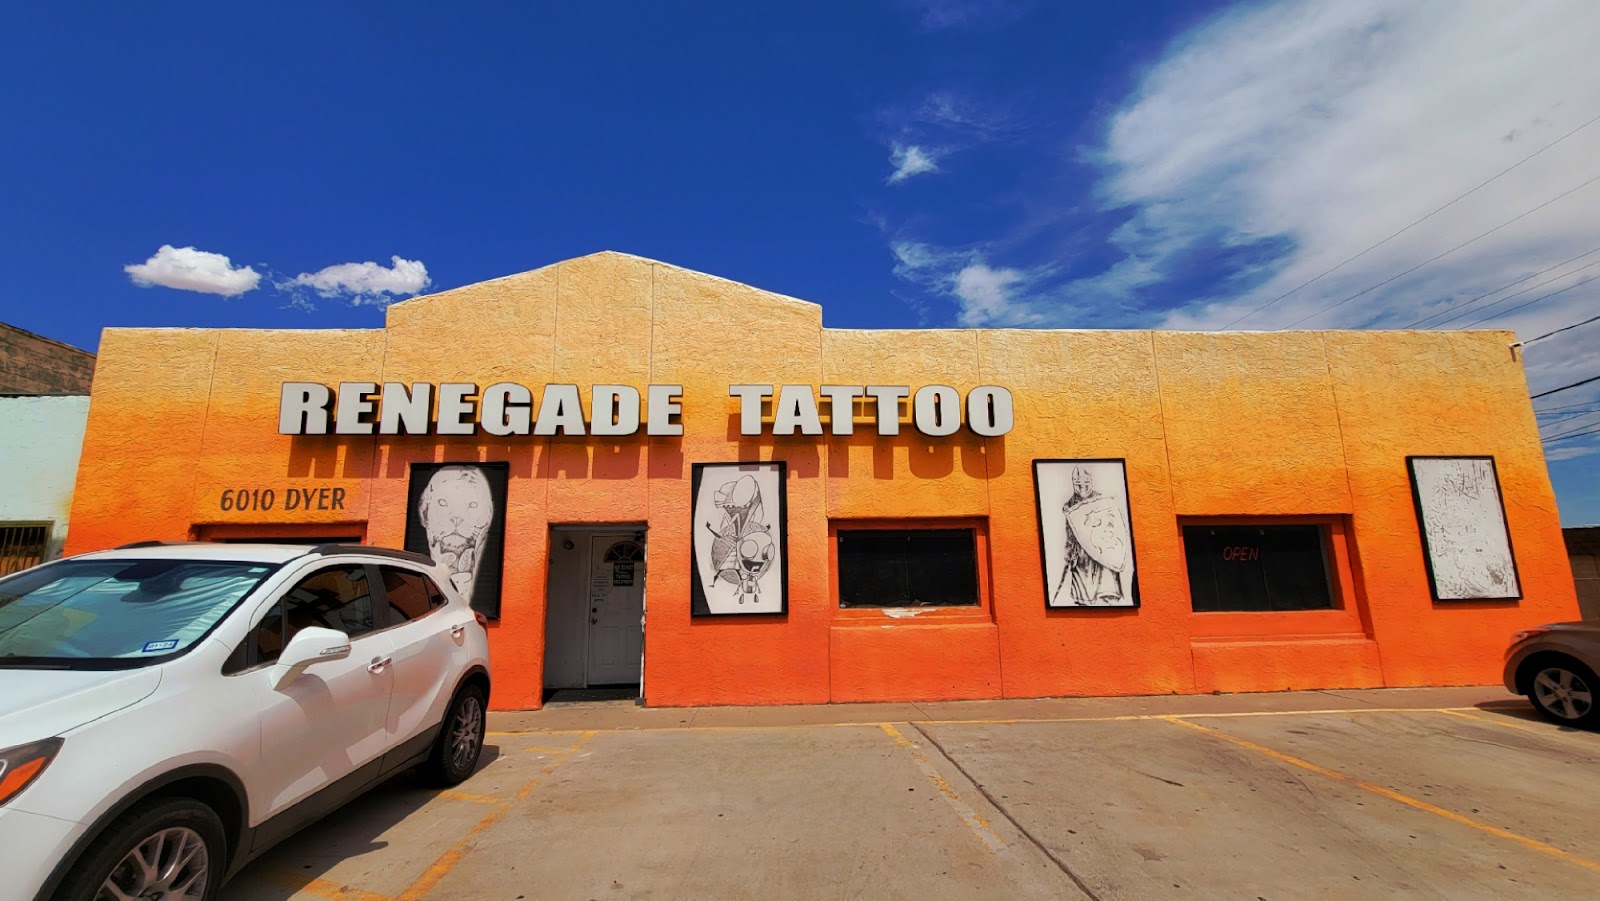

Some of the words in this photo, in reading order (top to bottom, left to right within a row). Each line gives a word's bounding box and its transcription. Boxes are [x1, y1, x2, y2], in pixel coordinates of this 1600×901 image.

[278, 381, 684, 436] RENEGADE
[729, 383, 1014, 437] TATTOO
[220, 488, 275, 511] 6010
[284, 487, 346, 511] DYER
[1223, 546, 1259, 561] OPEN
